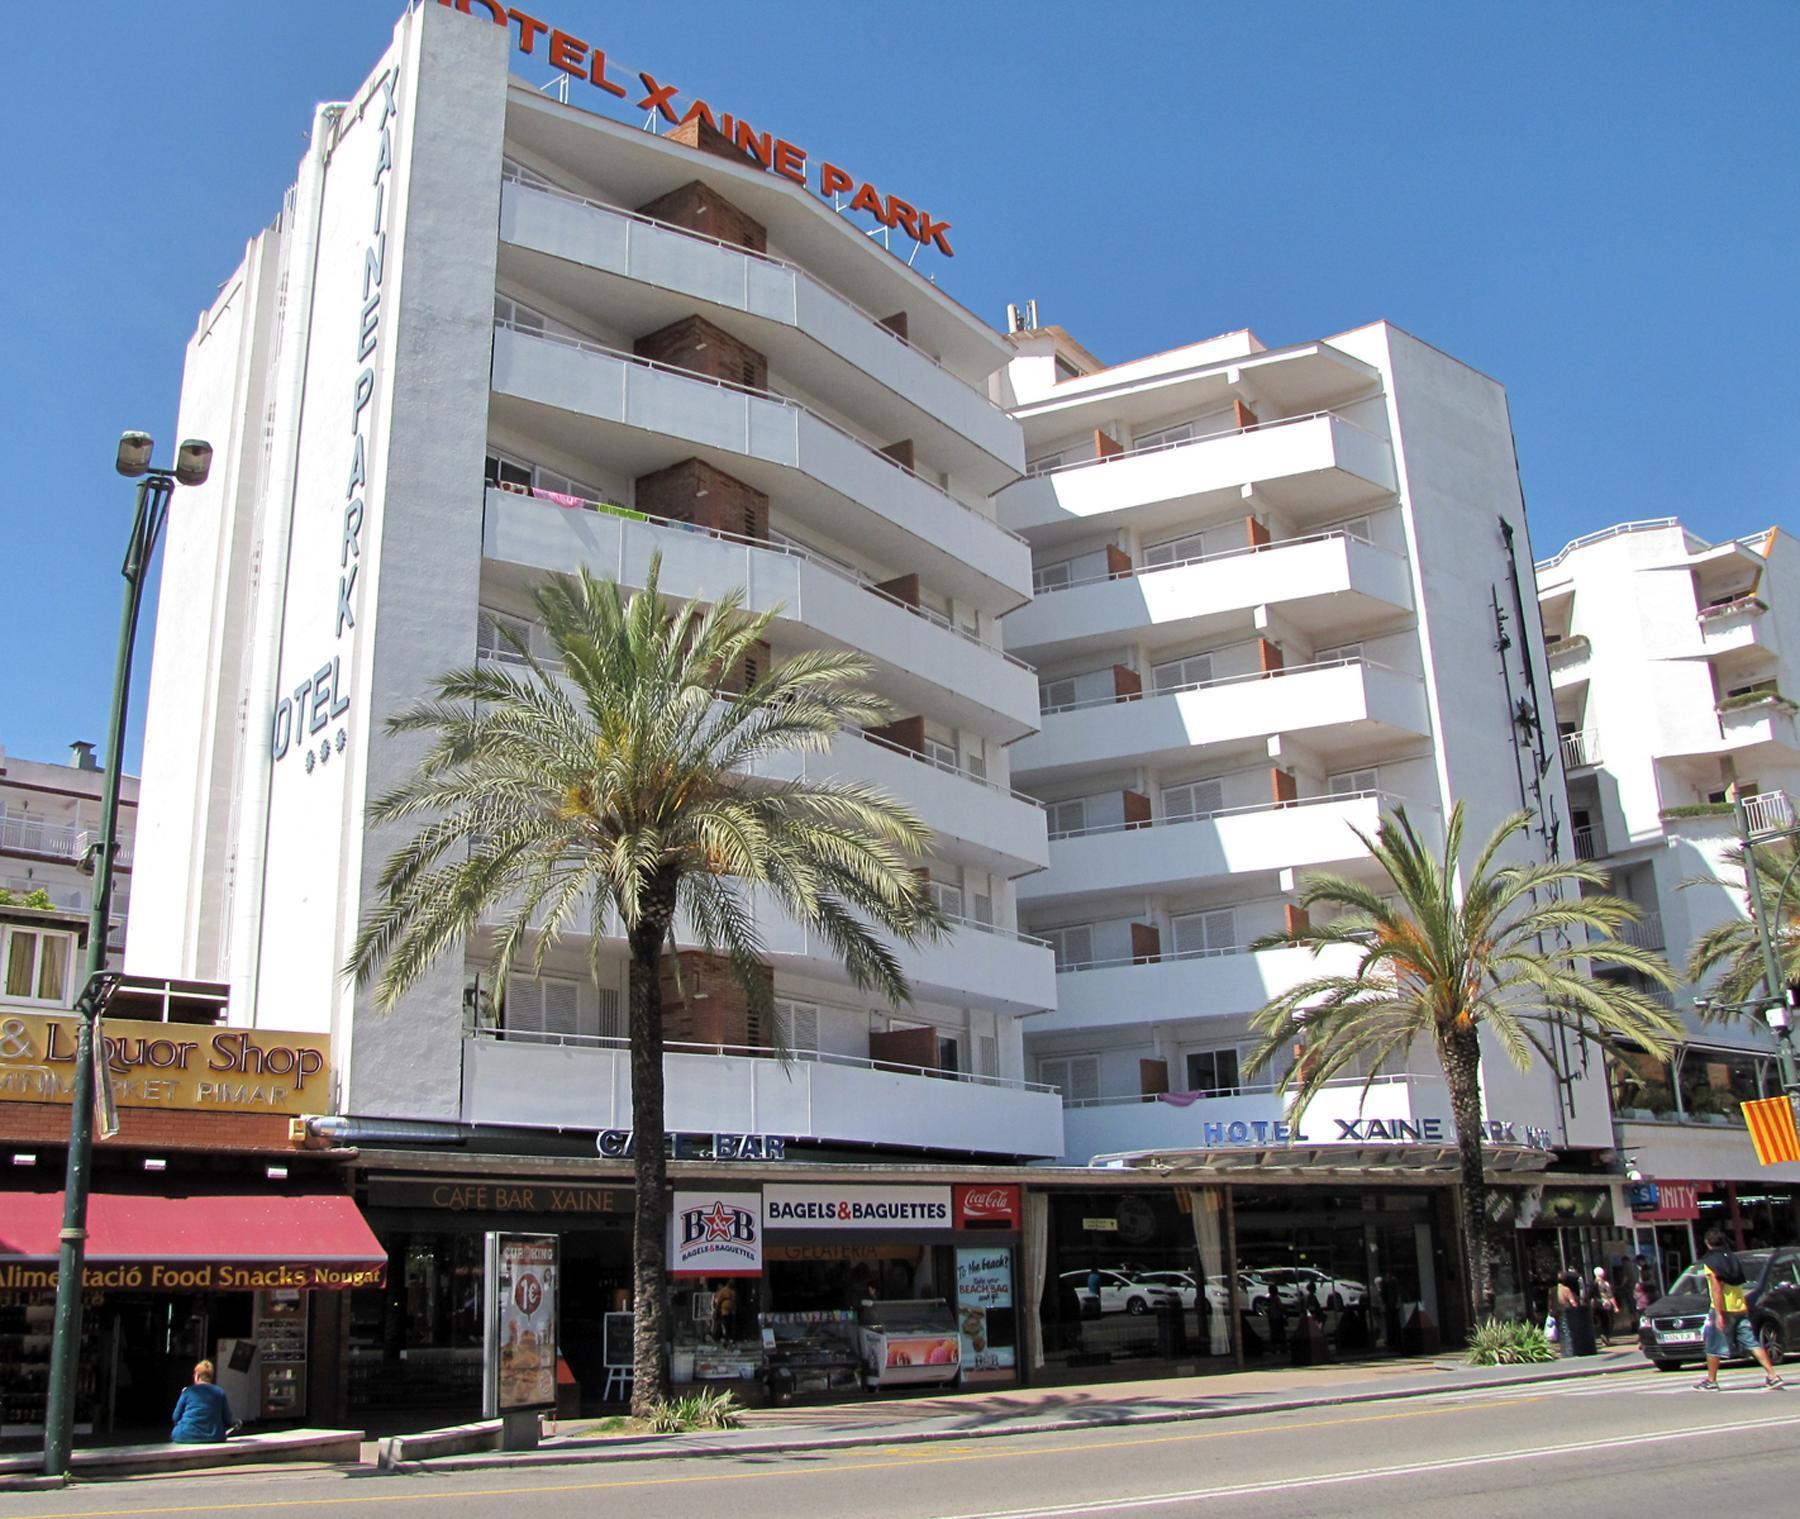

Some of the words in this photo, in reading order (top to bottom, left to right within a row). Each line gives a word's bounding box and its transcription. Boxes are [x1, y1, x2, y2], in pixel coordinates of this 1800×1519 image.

[437, 0, 626, 98] OTEL
[636, 71, 808, 183] XAINE
[819, 161, 955, 258] PARK
[357, 64, 400, 364] XAINE
[335, 367, 375, 640] PARK
[43, 1022, 199, 1075] Lquor
[207, 1032, 324, 1091] Shop
[196, 1081, 288, 1106] PIMAR
[1203, 1120, 1309, 1143] HOTEL
[1333, 1118, 1444, 1141] XAINE
[1449, 1120, 1517, 1142] ARK
[713, 1133, 785, 1160] BAR
[495, 1188, 536, 1209] BAR
[550, 1190, 614, 1212] XAINE
[1655, 1186, 1694, 1209] INITY
[680, 1201, 756, 1246] B&B
[982, 1254, 1009, 1271] beach?
[0, 1264, 142, 1288] limetació
[151, 1265, 211, 1287] Food
[218, 1265, 307, 1287] Snacks
[314, 1268, 382, 1288] Nougat
[959, 1284, 989, 1294] BEACH
[519, 1279, 538, 1310] 1€
